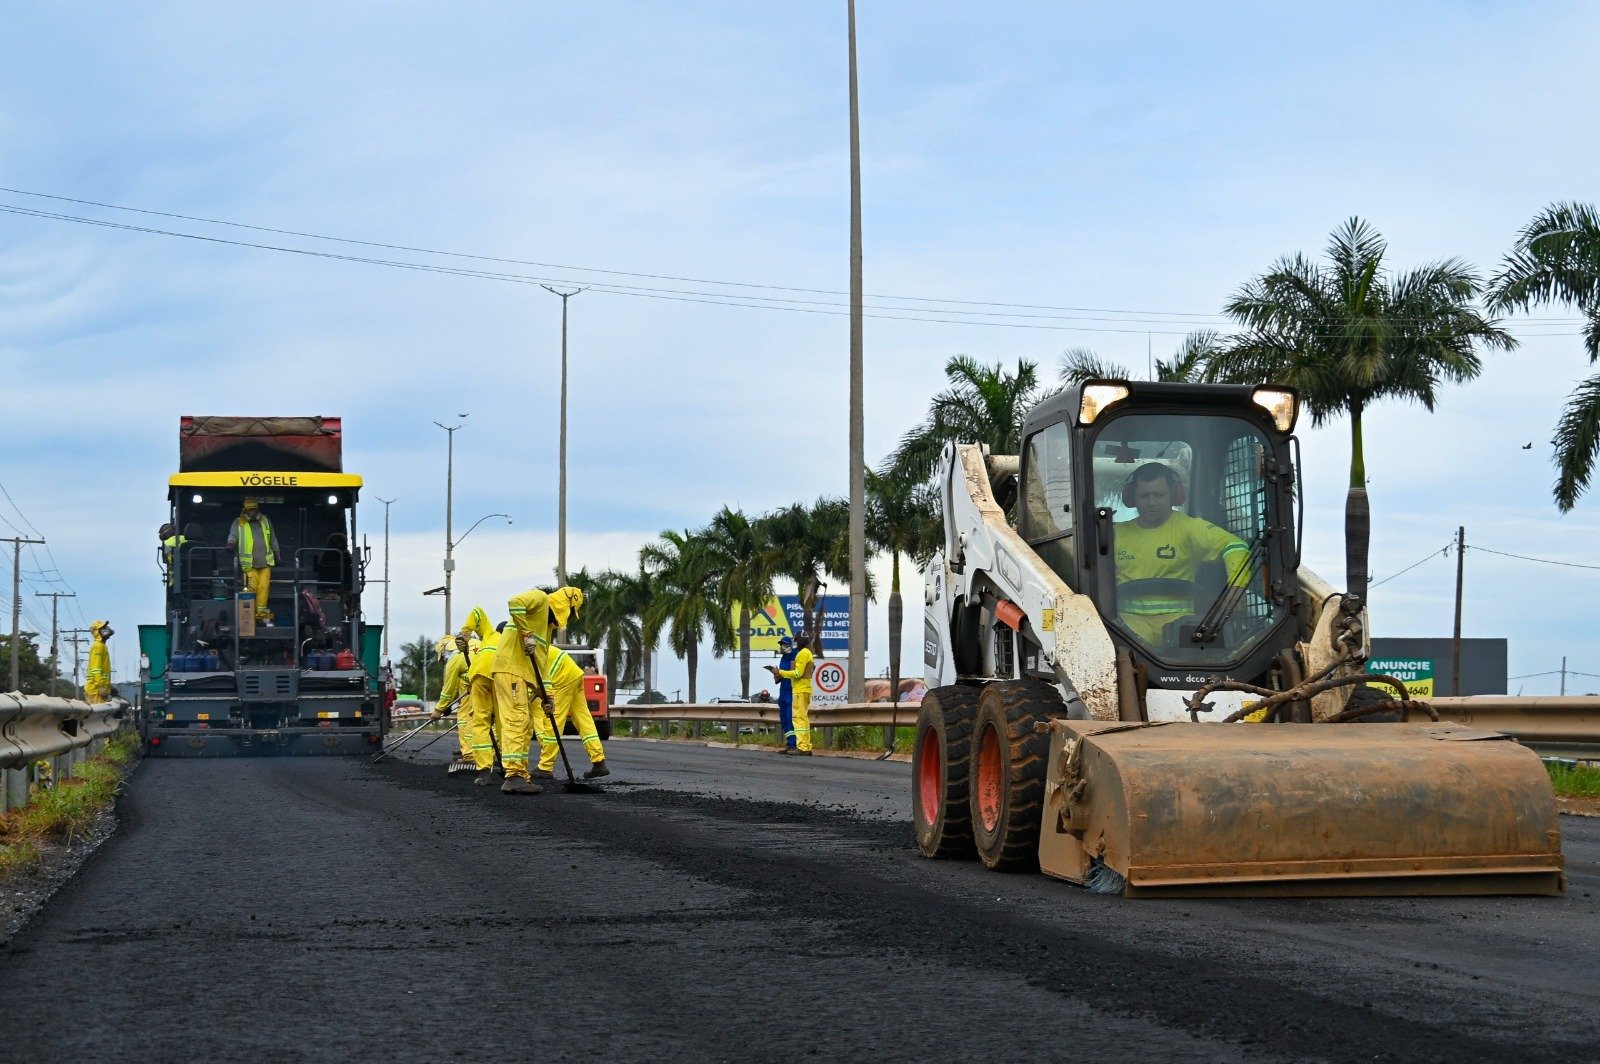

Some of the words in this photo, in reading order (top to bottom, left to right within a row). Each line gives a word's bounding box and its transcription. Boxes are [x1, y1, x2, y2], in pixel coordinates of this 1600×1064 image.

[240, 473, 298, 486] VÖGELE
[1369, 661, 1431, 671] ANUNCIE
[821, 669, 841, 683] 80
[811, 693, 849, 703] ISCALIZAÇÃ
